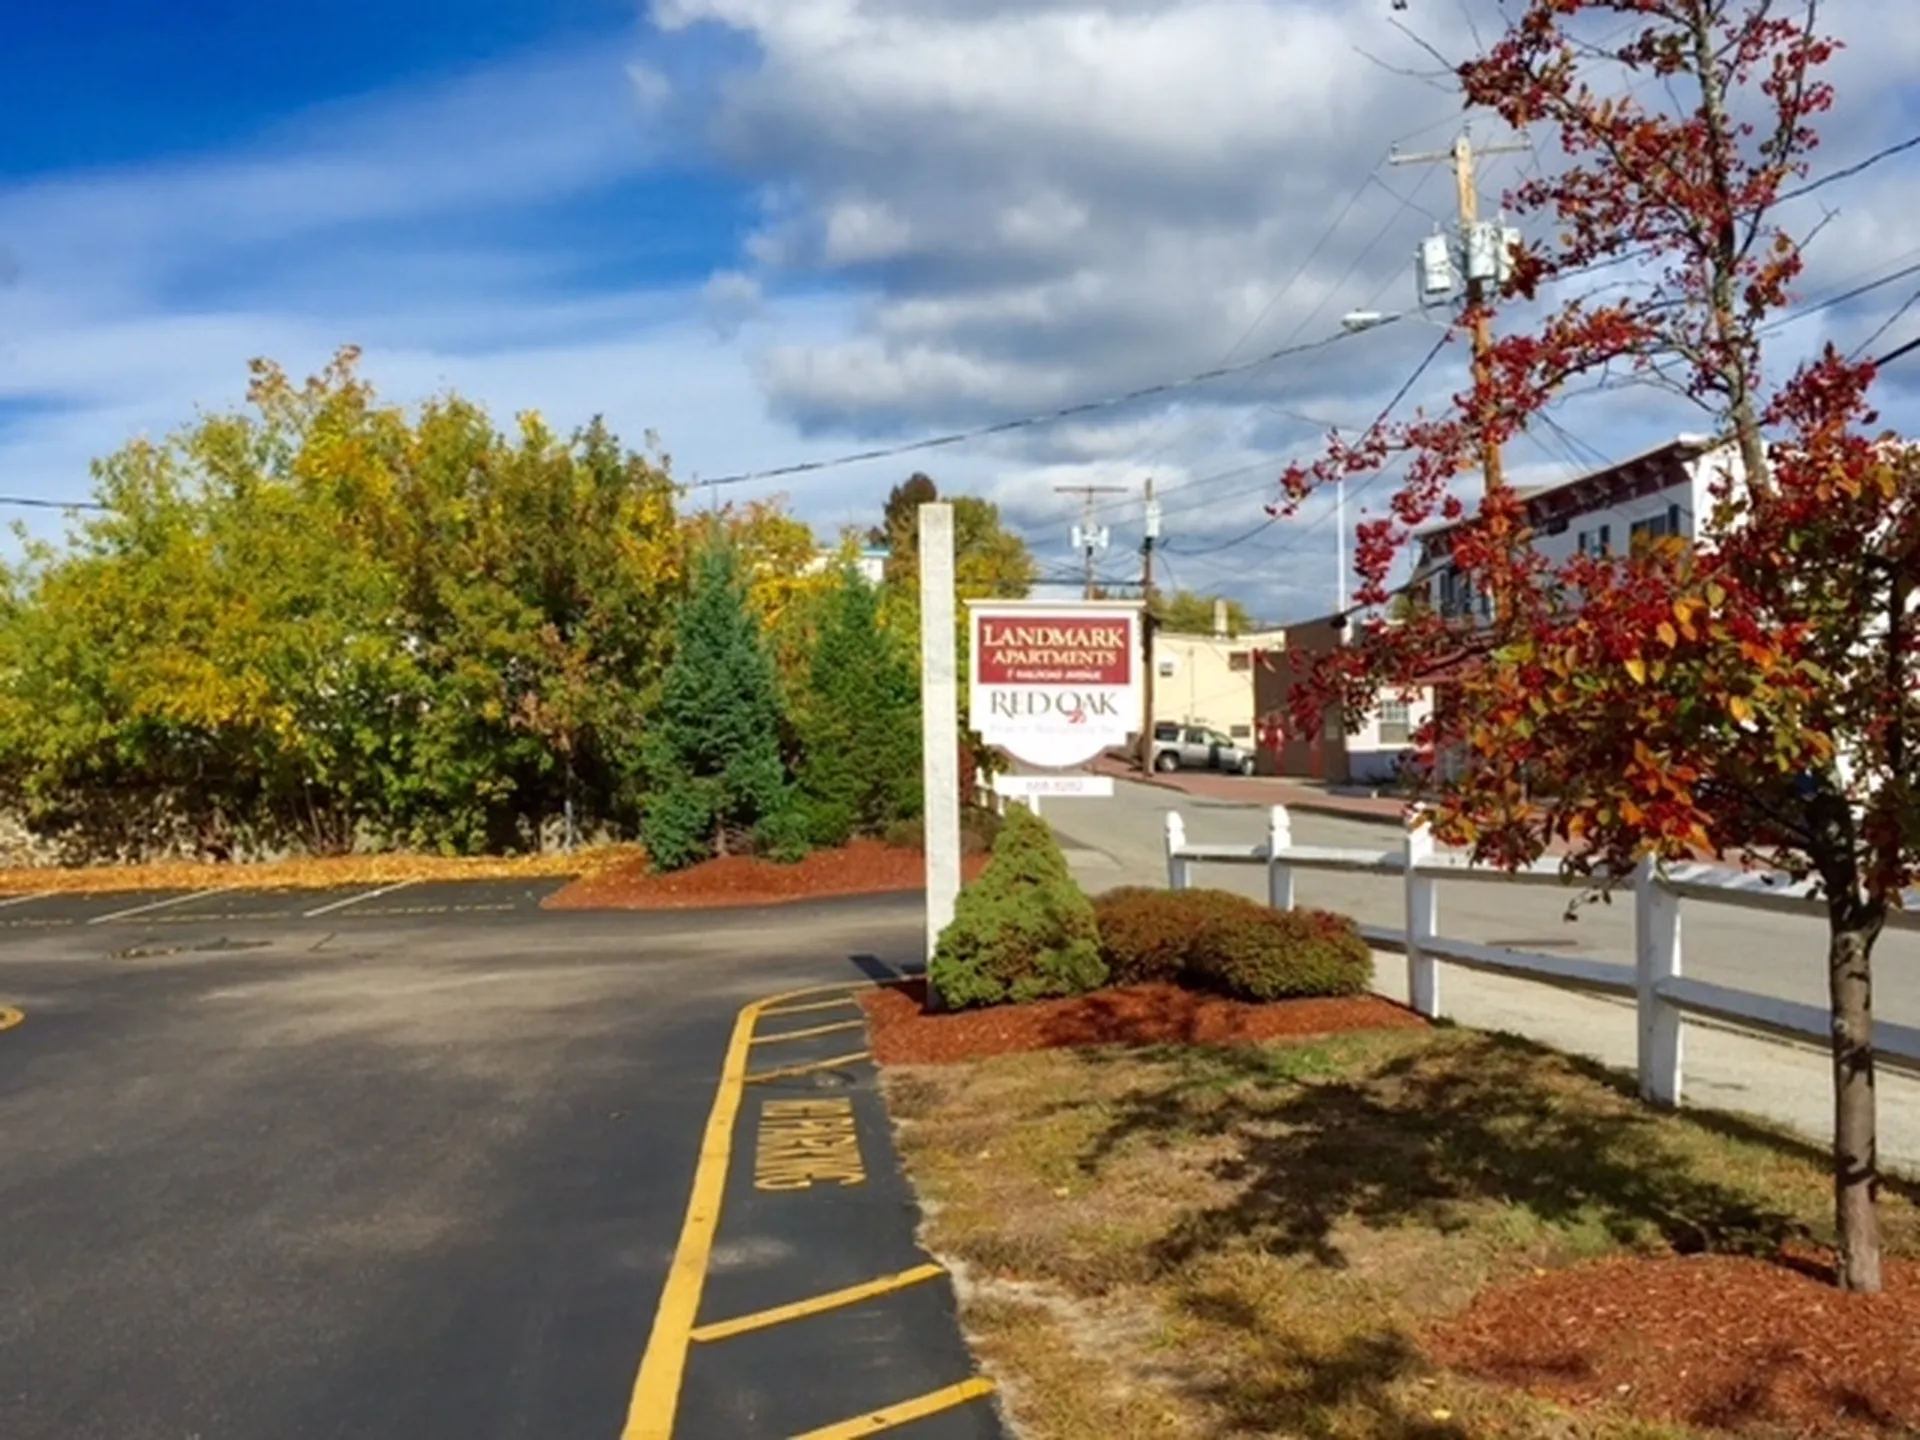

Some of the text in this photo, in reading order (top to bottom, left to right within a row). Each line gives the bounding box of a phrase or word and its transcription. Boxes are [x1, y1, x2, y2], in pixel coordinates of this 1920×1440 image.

[983, 625, 1125, 649] LANDMARK
[992, 650, 1117, 667] APARTMENTS
[990, 691, 1118, 719] RED OAK
